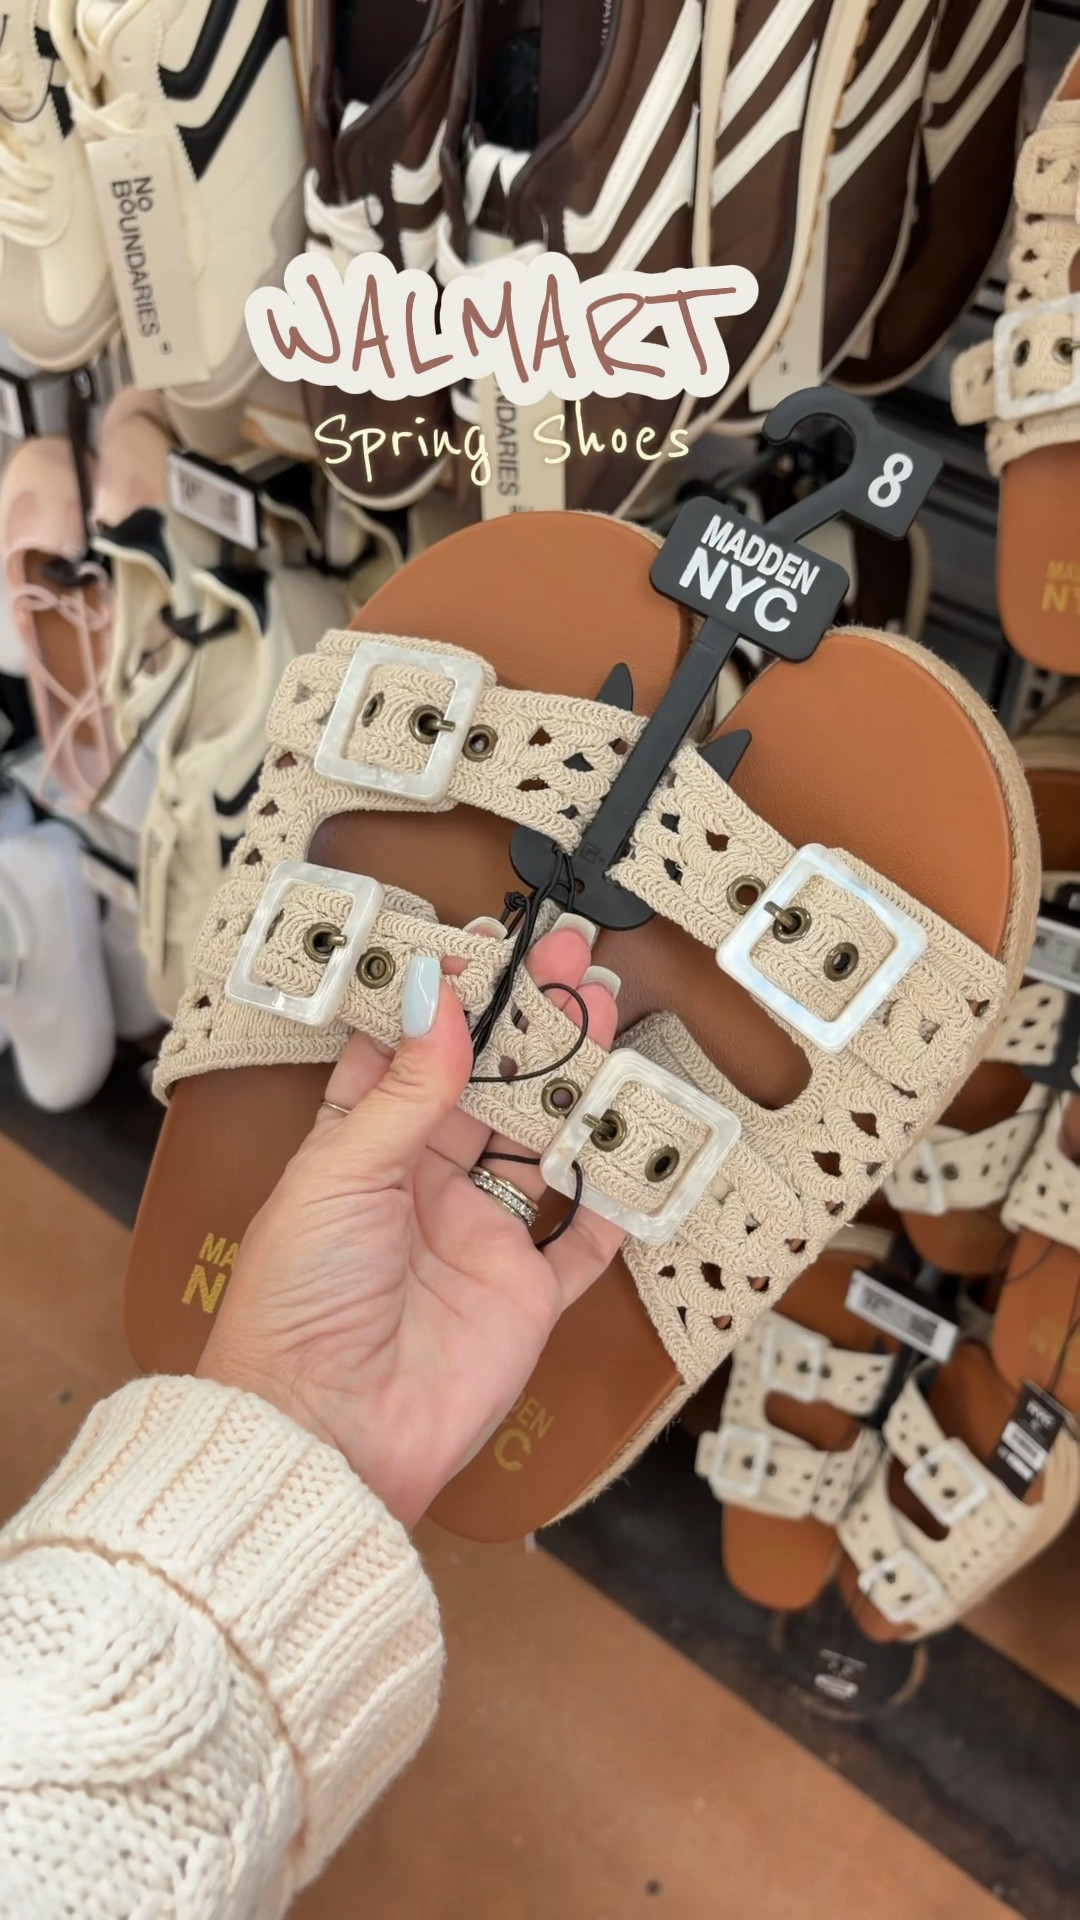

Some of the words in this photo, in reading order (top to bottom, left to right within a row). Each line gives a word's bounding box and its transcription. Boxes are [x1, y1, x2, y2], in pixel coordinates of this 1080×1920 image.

[134, 175, 154, 213] NO
[111, 179, 161, 338] BOUNDARIES
[867, 452, 914, 508] 8
[678, 546, 799, 633] NYC
[700, 514, 821, 596] MADDEN
